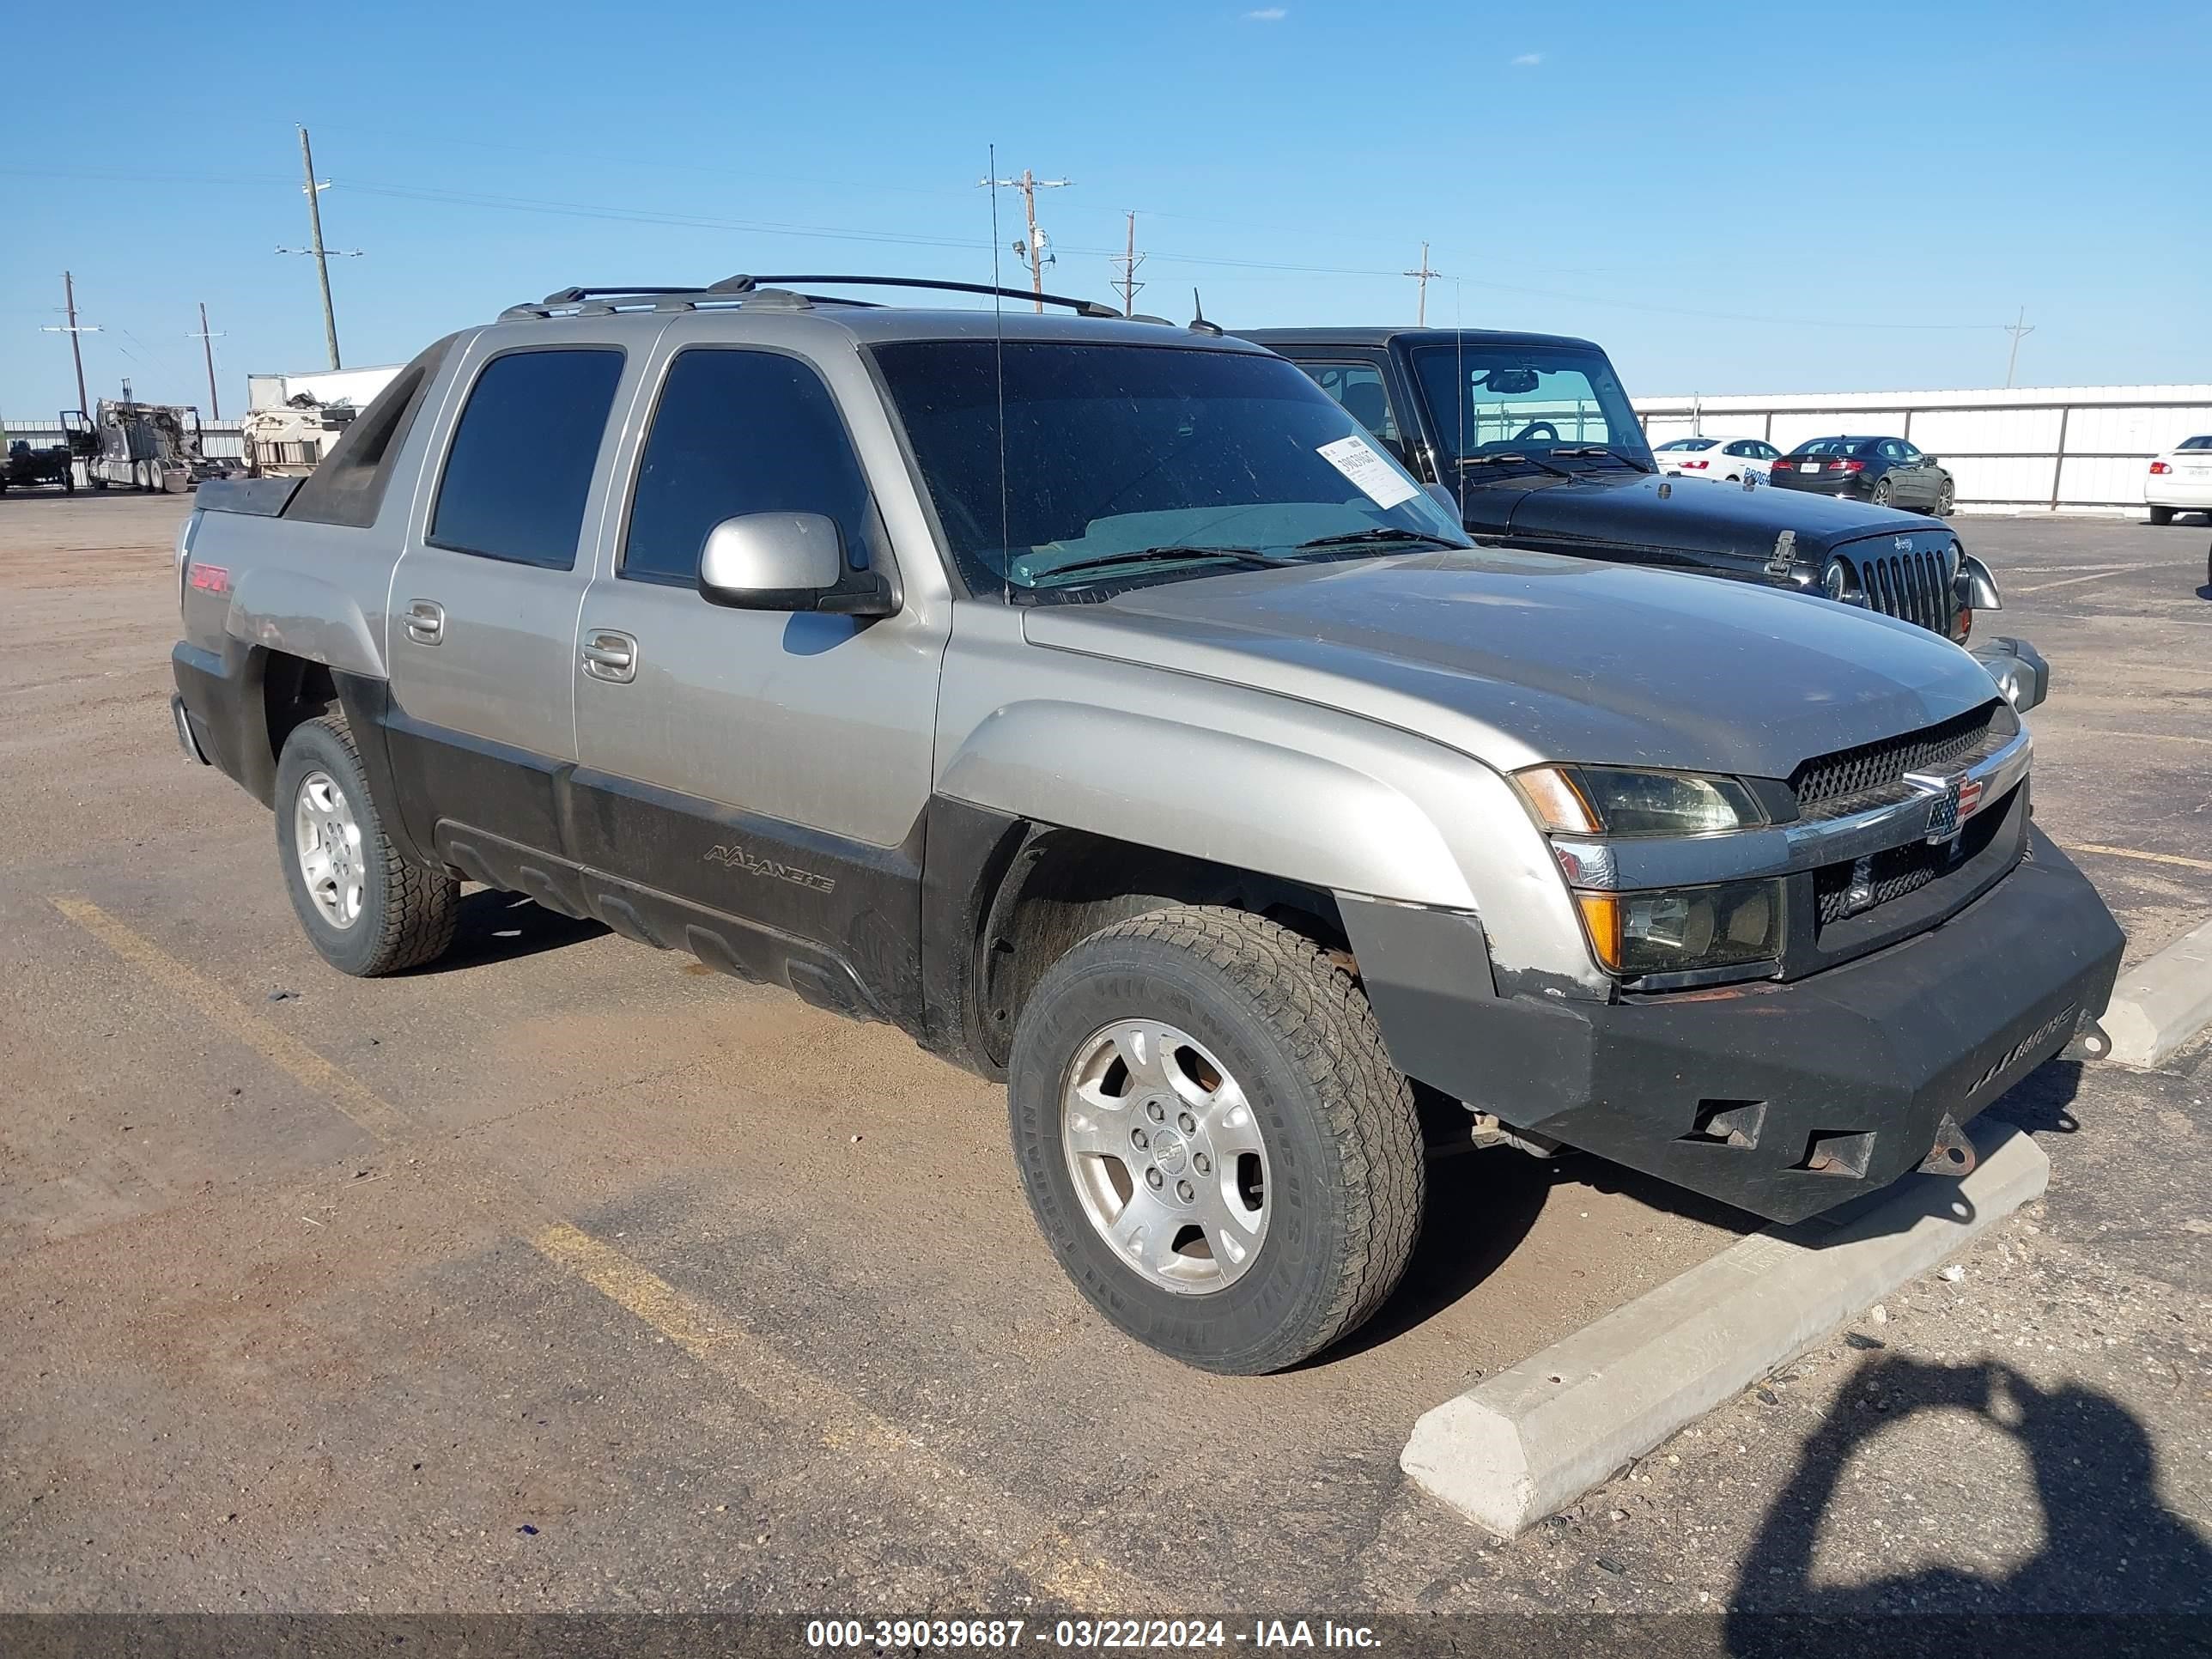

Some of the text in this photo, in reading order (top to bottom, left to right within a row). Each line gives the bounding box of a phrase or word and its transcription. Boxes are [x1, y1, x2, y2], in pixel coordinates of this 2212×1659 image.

[1894, 536, 1913, 551] Jeep
[191, 563, 228, 592] Z71
[704, 845, 836, 894] AVALANCHE
